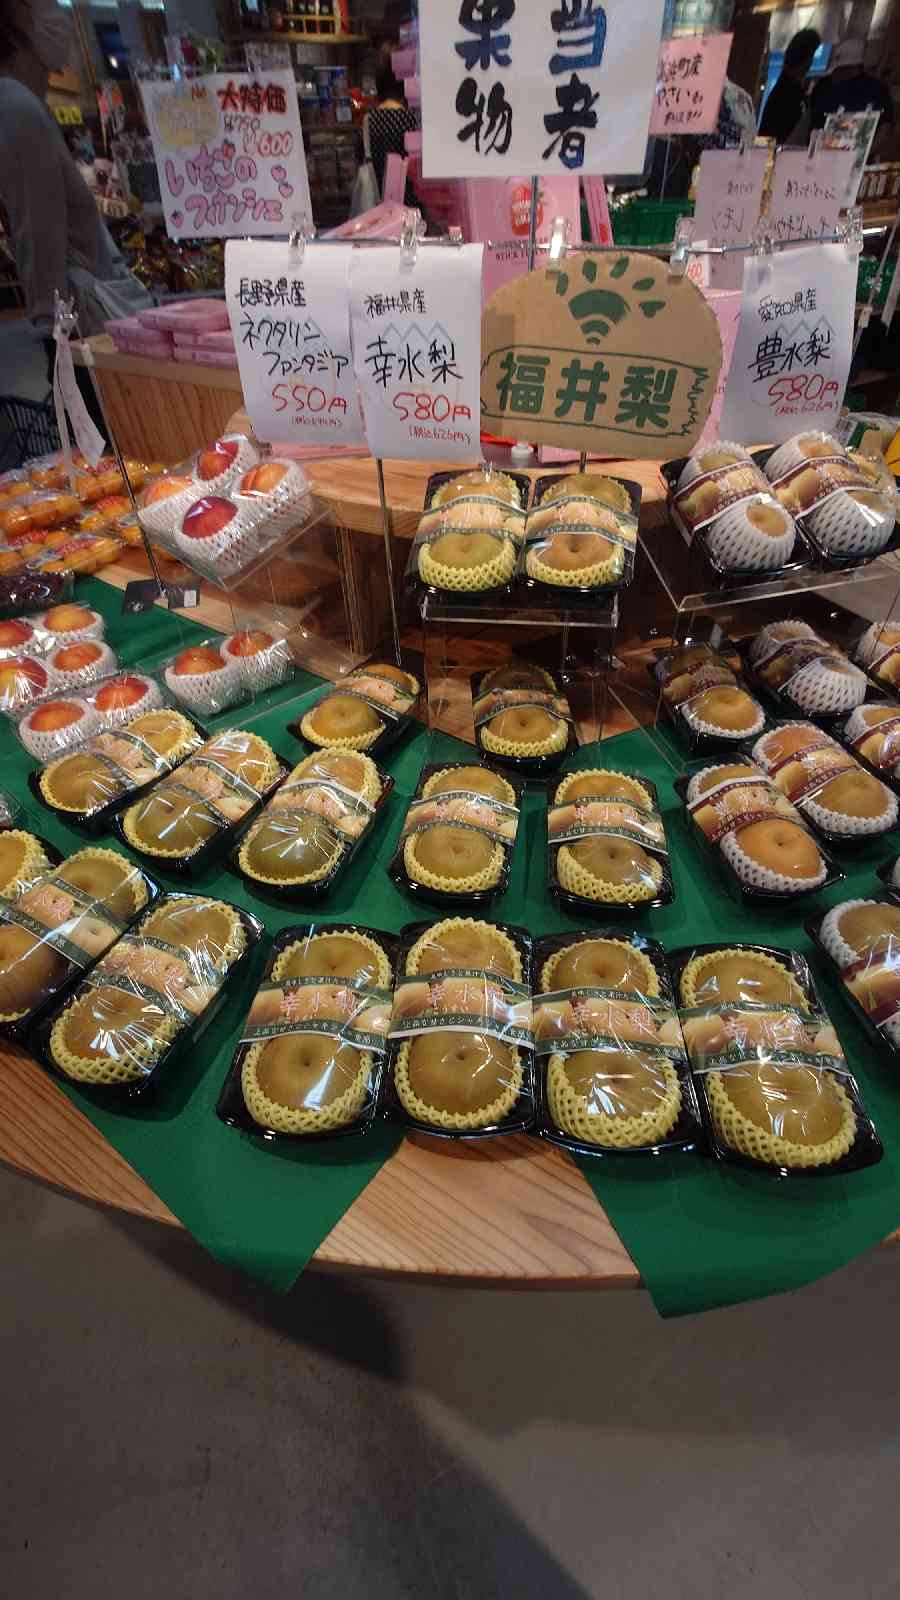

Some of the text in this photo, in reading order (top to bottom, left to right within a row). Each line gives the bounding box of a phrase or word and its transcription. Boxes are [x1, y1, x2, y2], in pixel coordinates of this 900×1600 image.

[216, 79, 288, 114] 大特価
[234, 277, 307, 307] 長野県産
[364, 288, 427, 317] 福井県産
[757, 287, 817, 322] 愛知県産
[240, 311, 320, 350] ネクタリン
[364, 336, 463, 388] 幸水梨
[748, 328, 830, 383] 豊水梨
[271, 383, 347, 414] 550円
[393, 392, 471, 422] 580円
[496, 351, 678, 428] 福井梨
[767, 373, 839, 407] 580円
